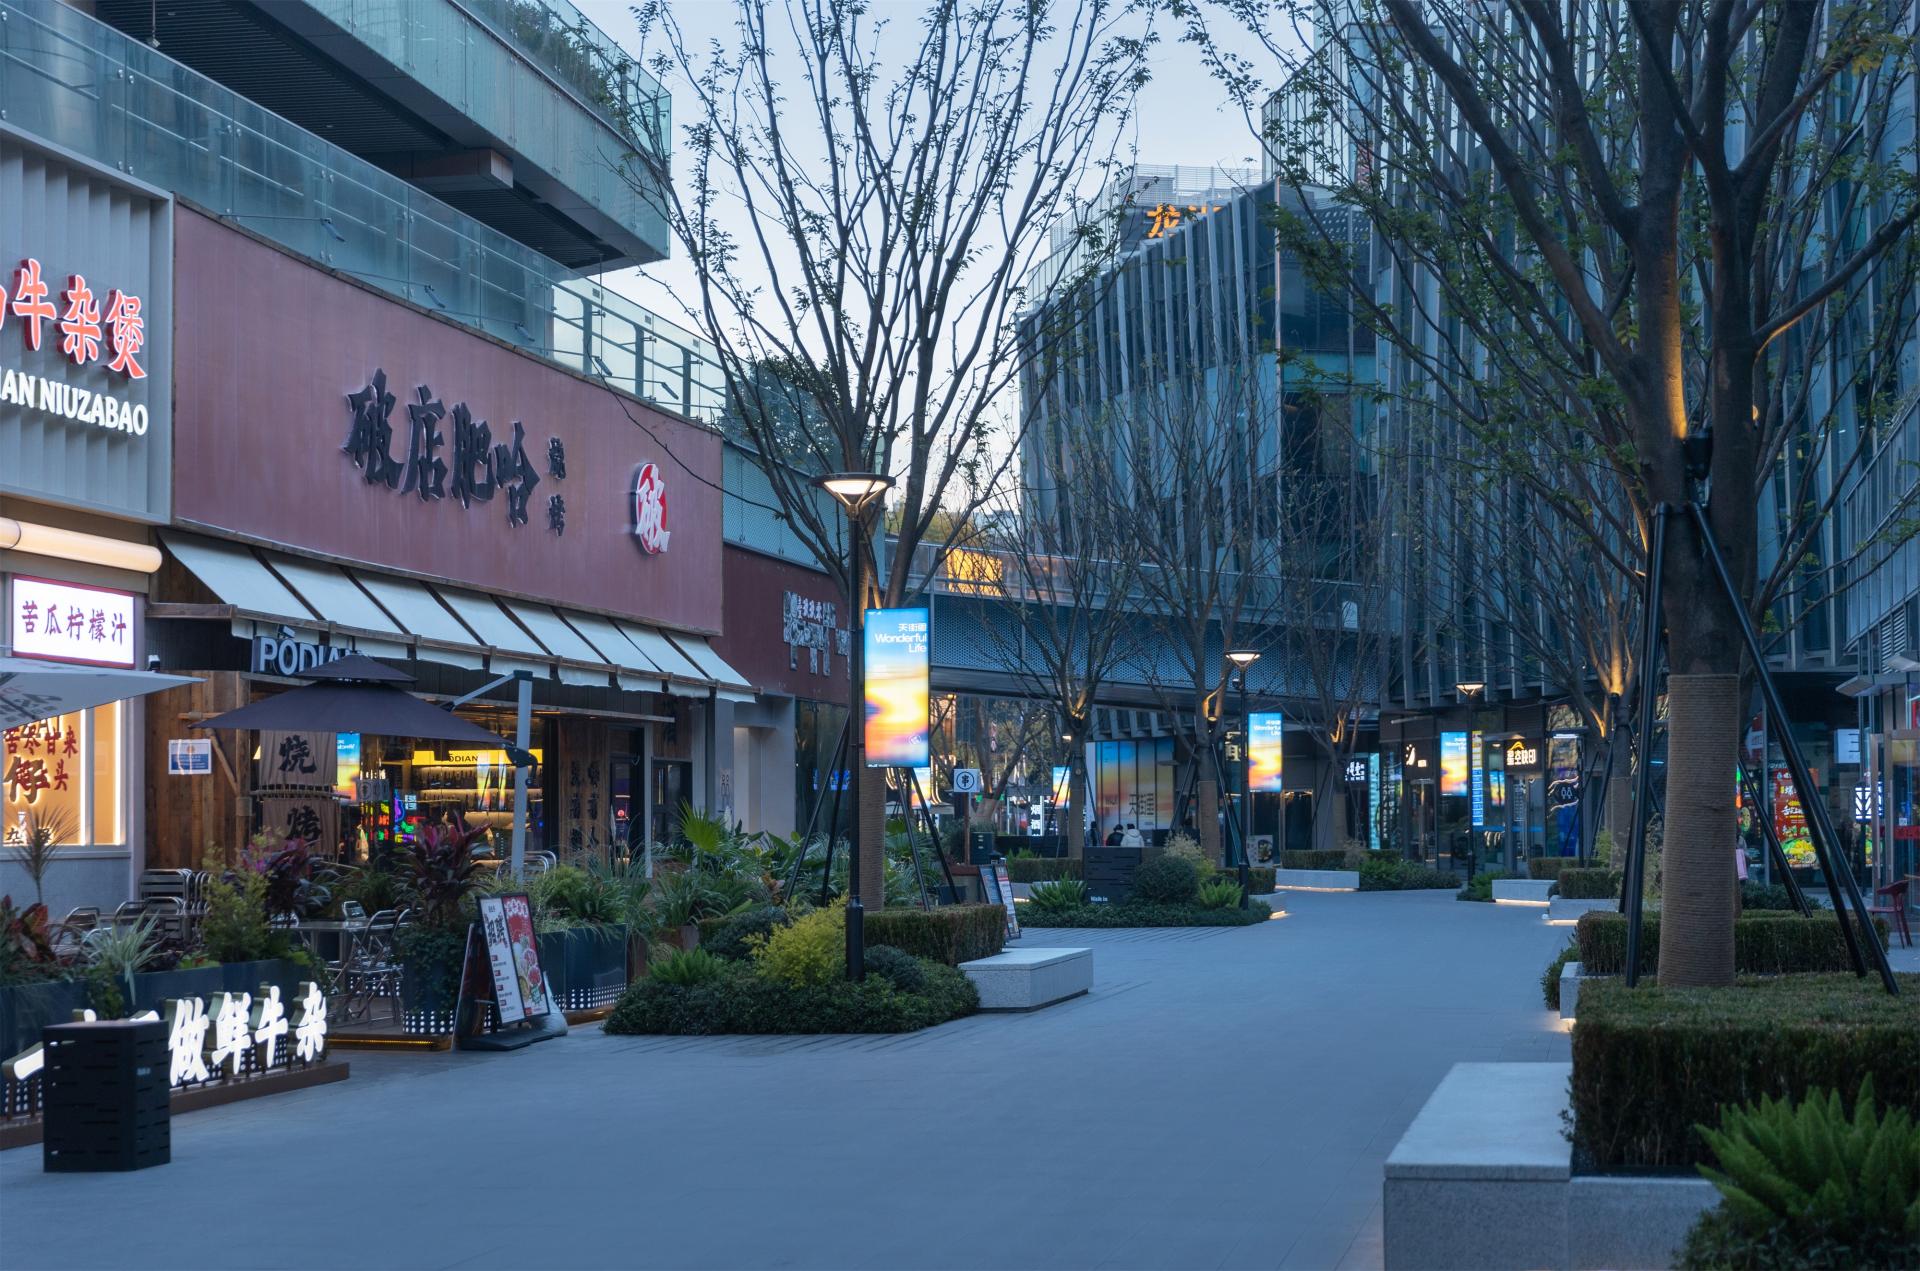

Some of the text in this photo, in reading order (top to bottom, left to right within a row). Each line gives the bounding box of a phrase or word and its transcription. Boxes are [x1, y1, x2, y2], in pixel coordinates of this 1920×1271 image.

[0, 258, 147, 379] 牛杂煲
[0, 366, 149, 436] AN NIUZABAO
[22, 601, 127, 645] 苦瓜柠檬汁
[875, 633, 927, 643] Wonderful
[908, 643, 927, 653] Life
[279, 735, 317, 773] 烧
[1030, 804, 1042, 837] 烟酒
[13, 981, 328, 1087] 一做鲜牛杂
